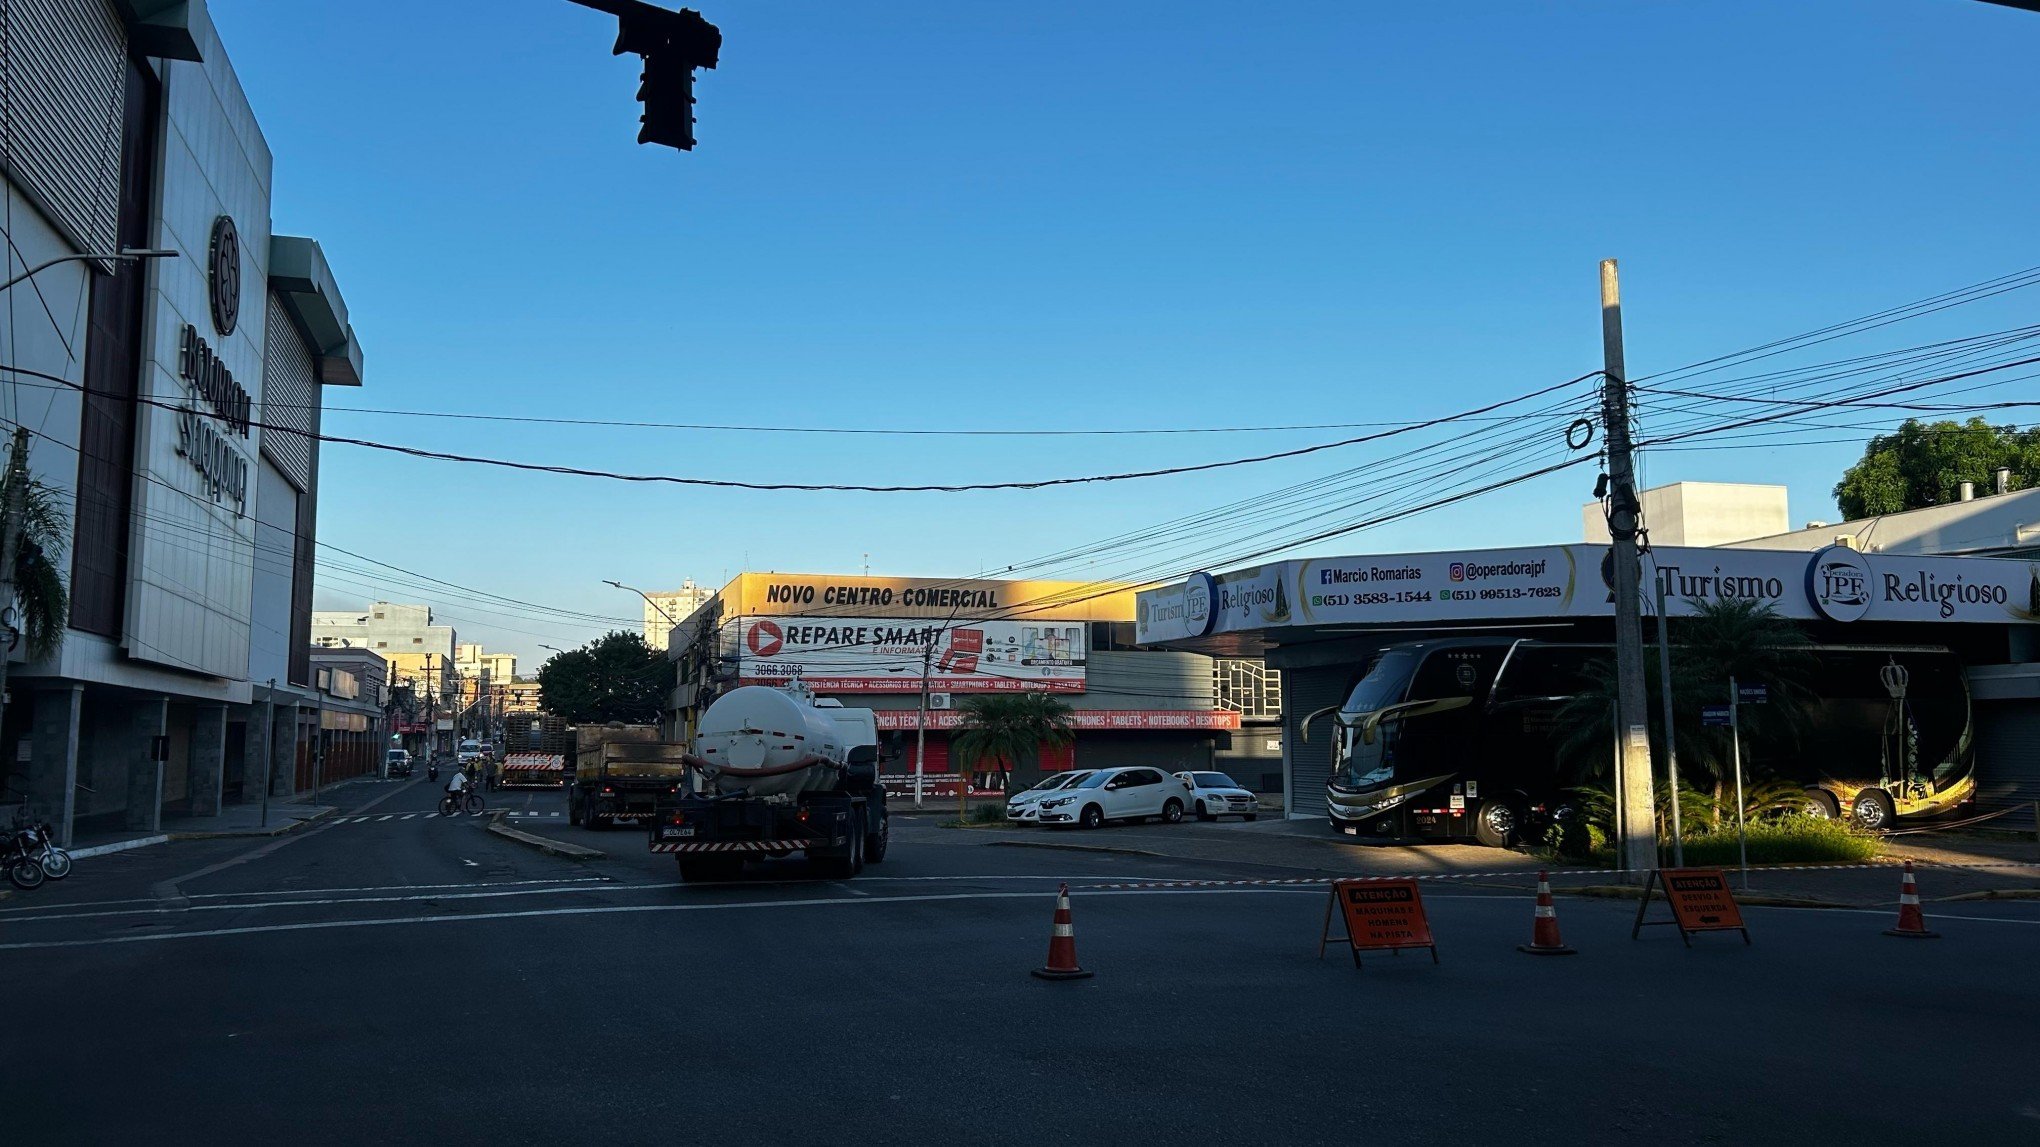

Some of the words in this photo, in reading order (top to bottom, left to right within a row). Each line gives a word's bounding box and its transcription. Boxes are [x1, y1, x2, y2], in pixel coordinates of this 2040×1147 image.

[181, 323, 251, 440] BOURBON
[1333, 569, 1368, 584] Marcio
[1371, 565, 1421, 582] Romarias
[1466, 559, 1546, 581] @operadorajpf
[1451, 588, 1476, 601] (51)
[1480, 586, 1561, 599] 99513-7623
[1656, 564, 1783, 599] Turismo
[1883, 571, 2008, 618] Religioso
[1820, 576, 1864, 598] JPF
[767, 584, 815, 604] NOVO
[824, 586, 893, 606] CENTRO
[903, 588, 998, 608] COMERCIAL
[1151, 601, 1184, 622] Turism
[1221, 584, 1275, 617] Religioso
[1323, 593, 1349, 606] (51)
[1353, 591, 1432, 606] 3583-1544
[1185, 595, 1207, 618] JPF
[786, 626, 868, 645] REPARE
[872, 627, 943, 646] SMART
[880, 646, 939, 655] INFORMÁTA
[755, 664, 802, 676] 3066.3068
[807, 679, 839, 689] SISTÊNCIA
[840, 679, 864, 689] TÉCNICA
[902, 681, 910, 689] DE
[911, 679, 946, 689] INFOMÁTICA
[951, 680, 989, 689] SMARTPHONES
[994, 680, 1016, 689] TABLETS
[1112, 715, 1142, 727] TABLETS
[1148, 716, 1190, 727] NOTEBOOKS
[1195, 716, 1231, 727] DESKTOPS
[1676, 879, 1717, 889] ATENÇÃO
[1354, 889, 1408, 901] ATENÇÃO
[1408, 906, 1414, 914] E
[1683, 904, 1728, 912] ESQUERDA
[1368, 918, 1409, 927] HOMENS
